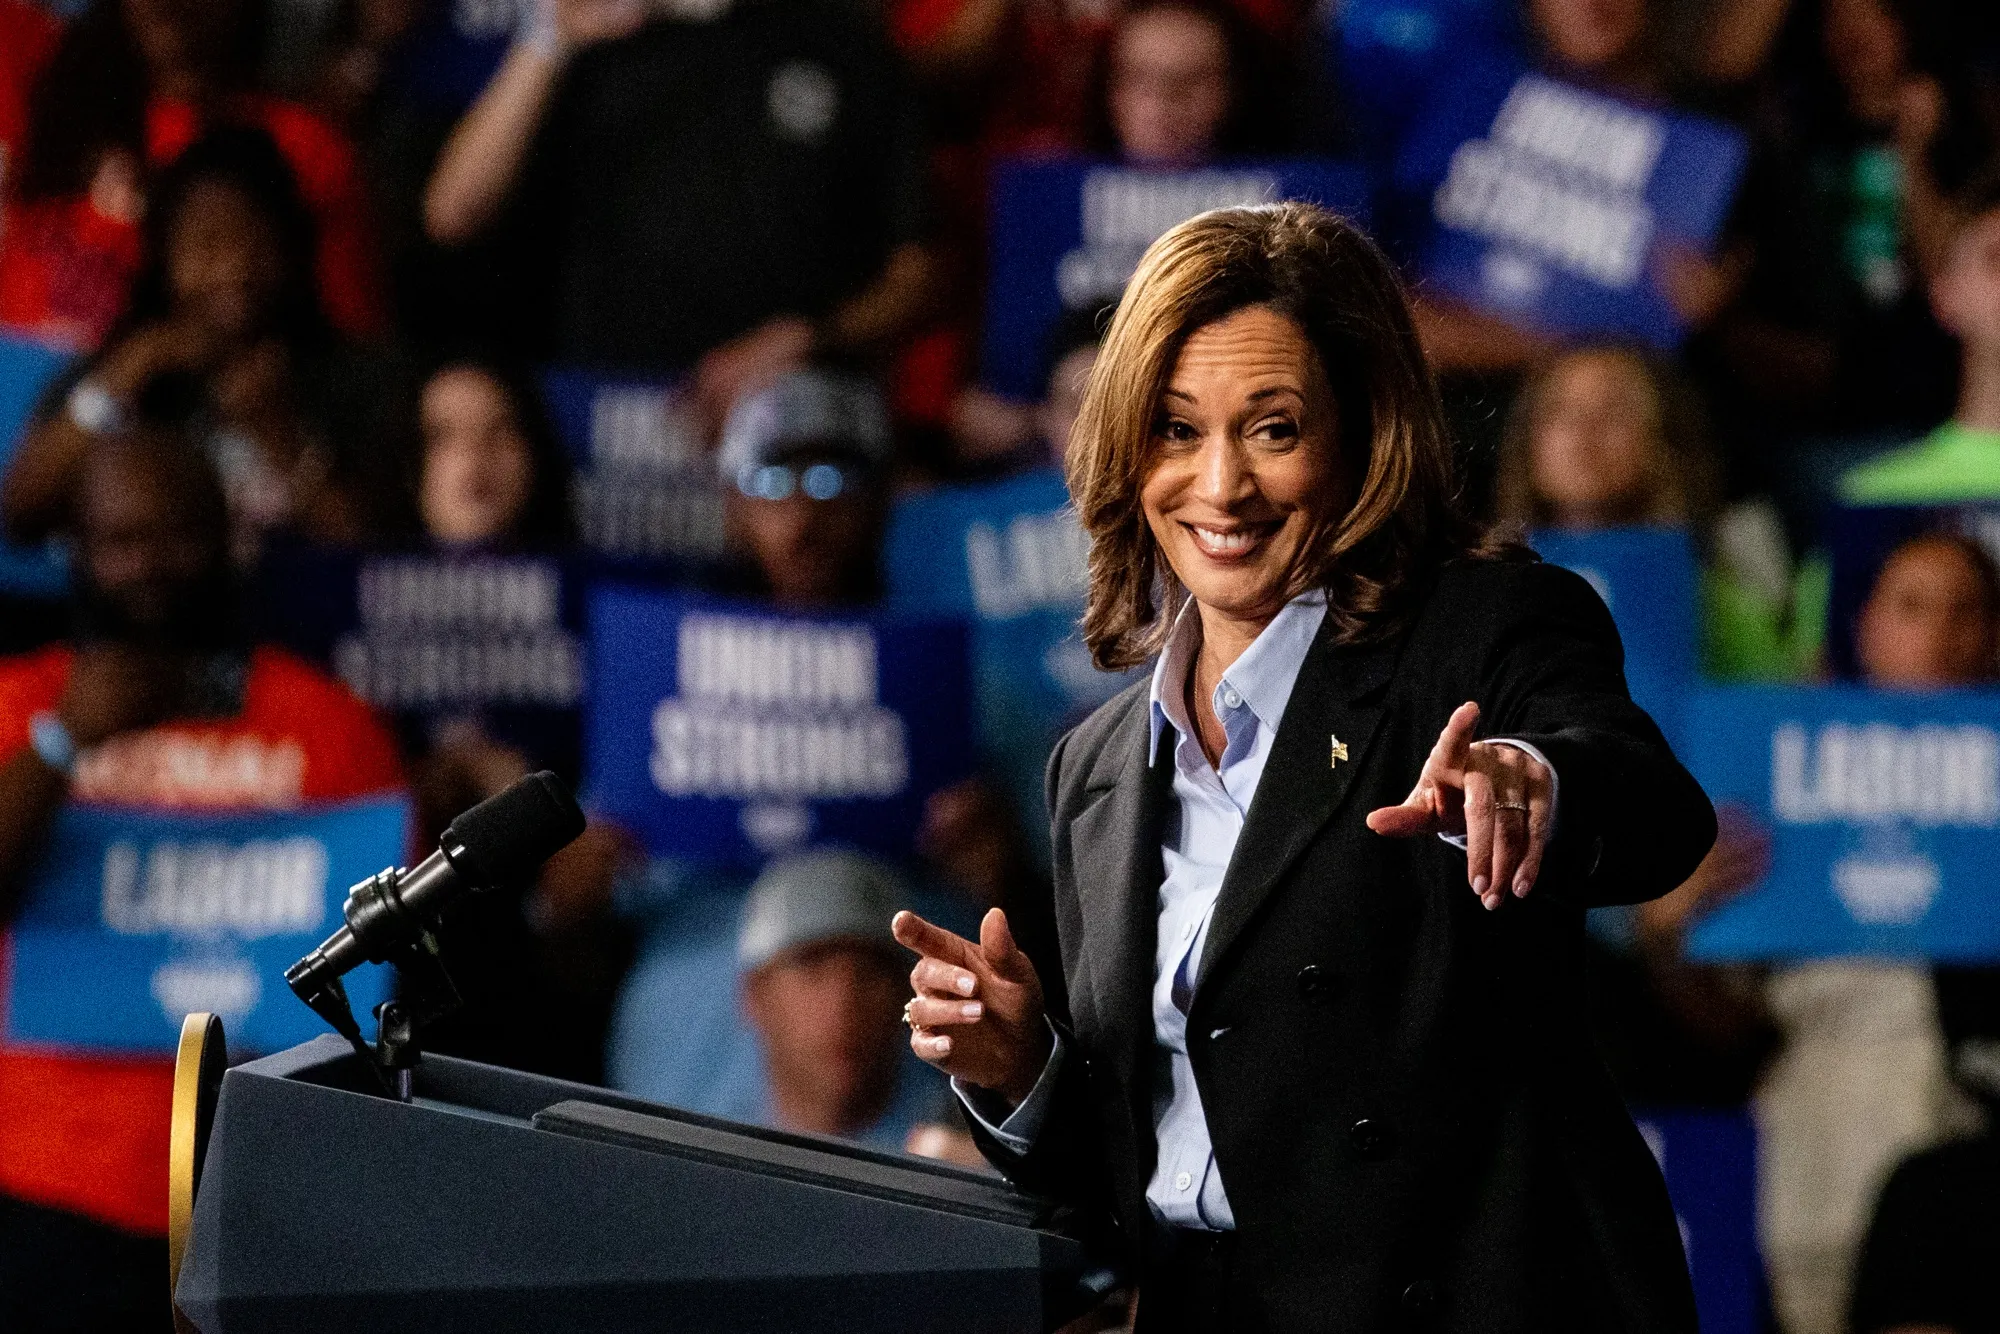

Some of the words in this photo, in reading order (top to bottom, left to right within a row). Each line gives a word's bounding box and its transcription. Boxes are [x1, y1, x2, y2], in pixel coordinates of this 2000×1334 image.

[677, 612, 878, 699] UNION
[1772, 722, 1997, 828] LABOR
[102, 837, 328, 937] LABOR
